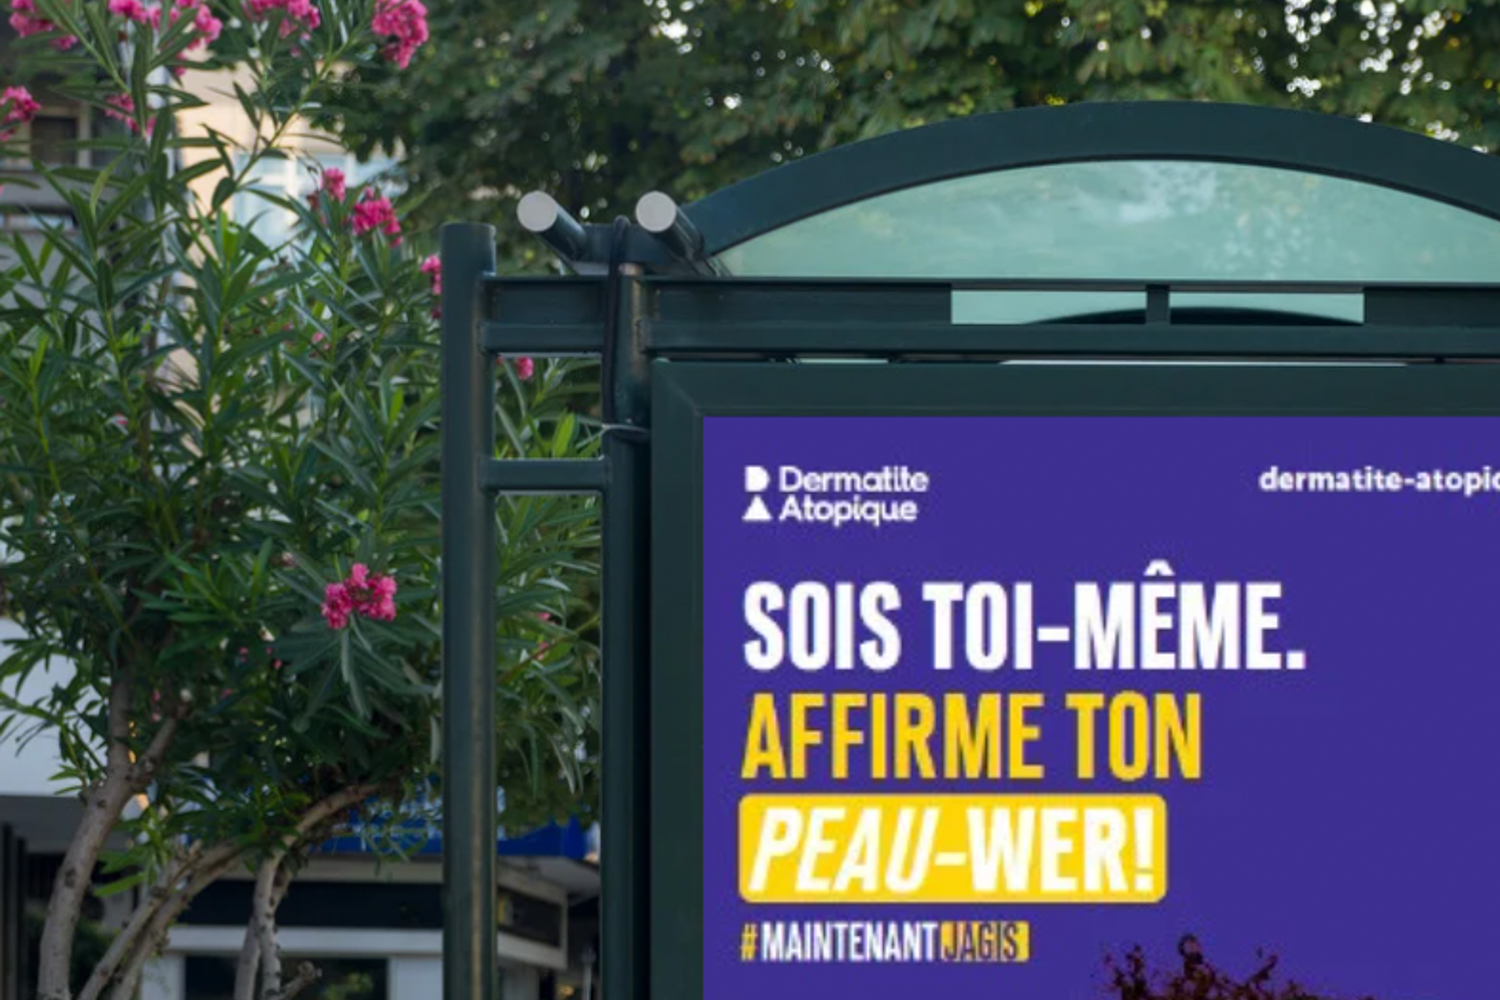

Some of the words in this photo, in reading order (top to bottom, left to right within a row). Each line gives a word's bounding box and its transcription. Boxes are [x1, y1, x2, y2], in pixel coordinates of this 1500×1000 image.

[778, 494, 918, 527] Atopique
[779, 465, 929, 492] Dermatite
[743, 580, 901, 671] SOIS
[922, 559, 1306, 671] TOI-MÊME.
[741, 690, 1044, 782] AFFIRME
[1065, 690, 1201, 782] TON
[748, 806, 1155, 894] PEAU-WER!
